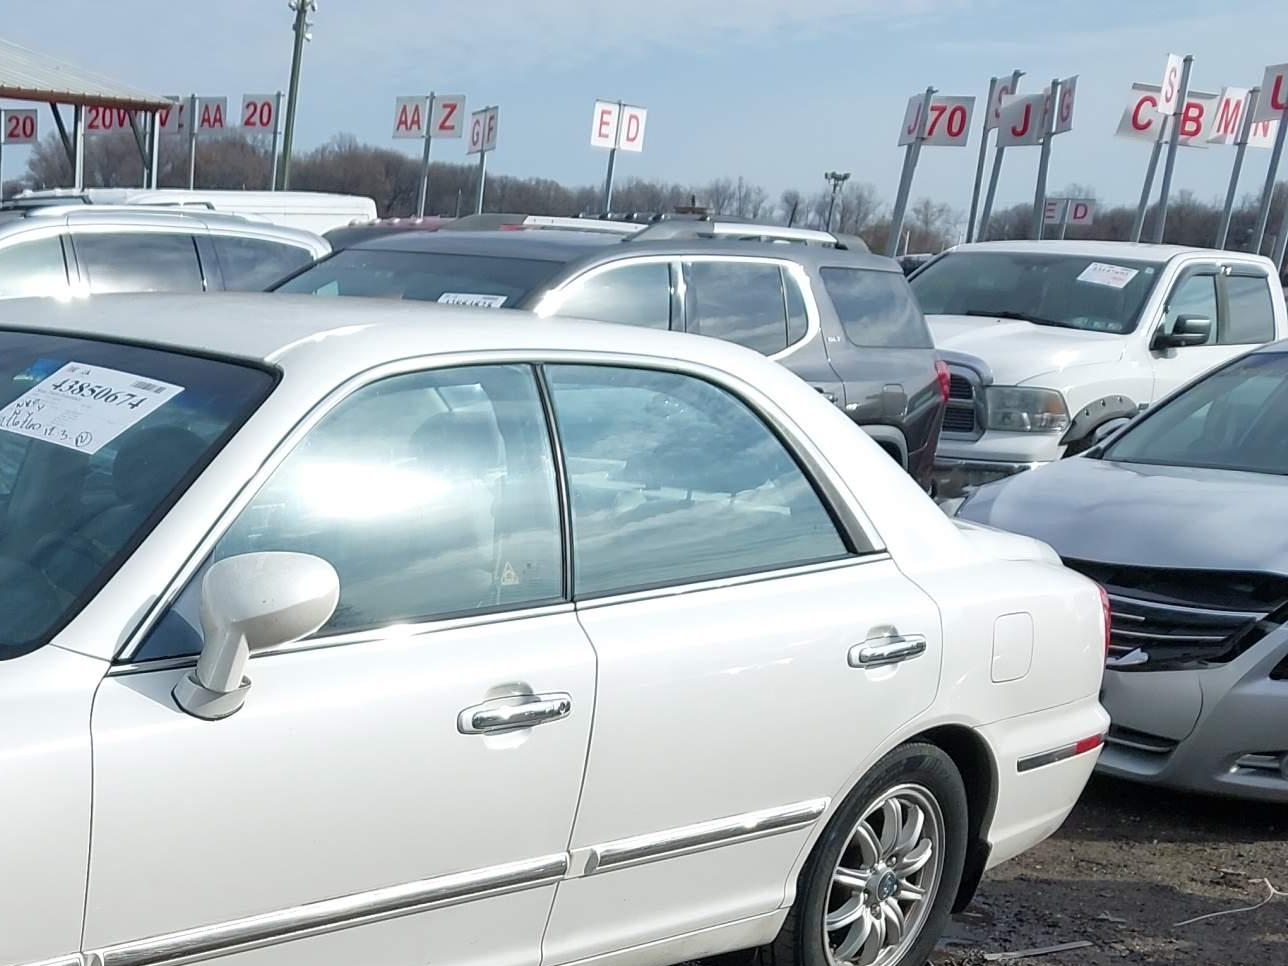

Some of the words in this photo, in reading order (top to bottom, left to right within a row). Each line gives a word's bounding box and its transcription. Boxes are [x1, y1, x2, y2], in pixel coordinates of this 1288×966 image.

[1165, 66, 1177, 103] S
[7, 115, 35, 138] 20
[200, 103, 224, 129] AA
[244, 101, 272, 128] 20
[396, 104, 422, 131] AA
[439, 103, 458, 131] Z
[598, 109, 612, 139] E
[907, 101, 922, 136] J
[927, 104, 967, 137] 70
[1011, 103, 1032, 137] J
[1131, 95, 1158, 131] C
[1180, 102, 1205, 137] B
[1216, 97, 1242, 134] M
[472, 119, 481, 146] G
[487, 114, 496, 144] F
[626, 114, 640, 143] D
[1073, 202, 1089, 220] D
[52, 378, 148, 410] 43850674
